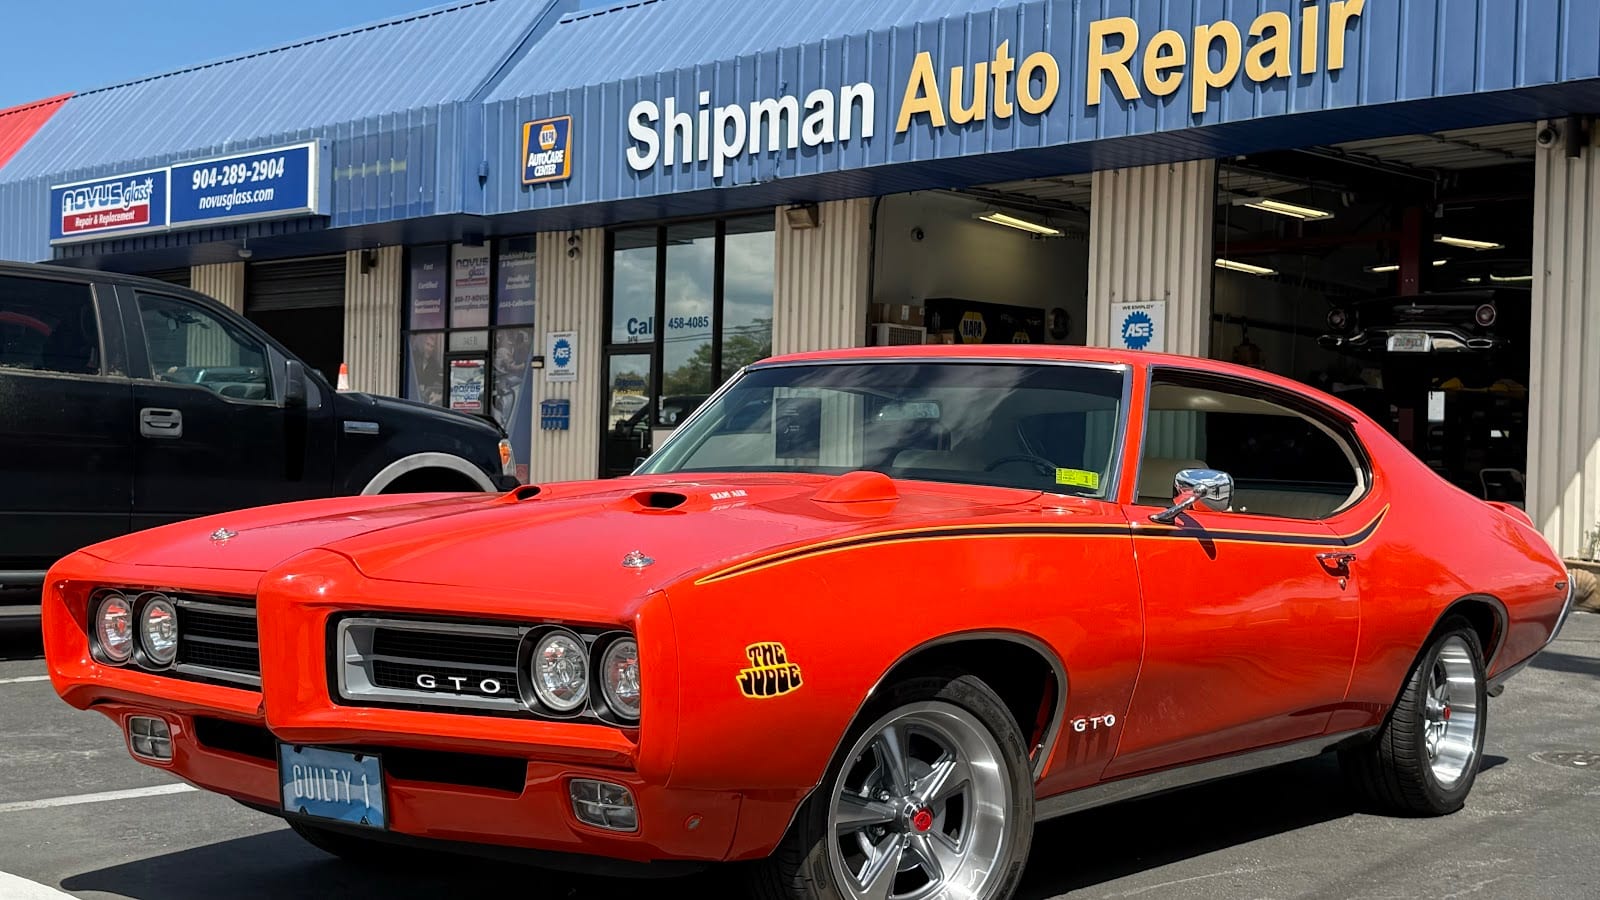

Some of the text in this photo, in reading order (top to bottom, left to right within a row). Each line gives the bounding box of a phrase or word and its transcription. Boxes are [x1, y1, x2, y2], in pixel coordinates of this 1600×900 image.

[626, 0, 1367, 178] Shipman Auto Repair
[192, 156, 285, 190] 904-289-2904
[534, 164, 556, 177] CENTER
[122, 180, 149, 210] glass
[199, 188, 275, 211] novusglass.com
[75, 210, 135, 229] Repair & Replacement
[668, 316, 709, 329] 458-4085
[963, 320, 982, 338] NAPA
[1124, 323, 1150, 338] ASE
[555, 347, 569, 359] ASE
[710, 489, 748, 500] RAM AIR
[747, 643, 786, 668] THE
[416, 674, 501, 694] GTO
[738, 665, 801, 696] JUDGE
[1073, 714, 1116, 732] GTO
[293, 764, 370, 809] GUILTY 1
